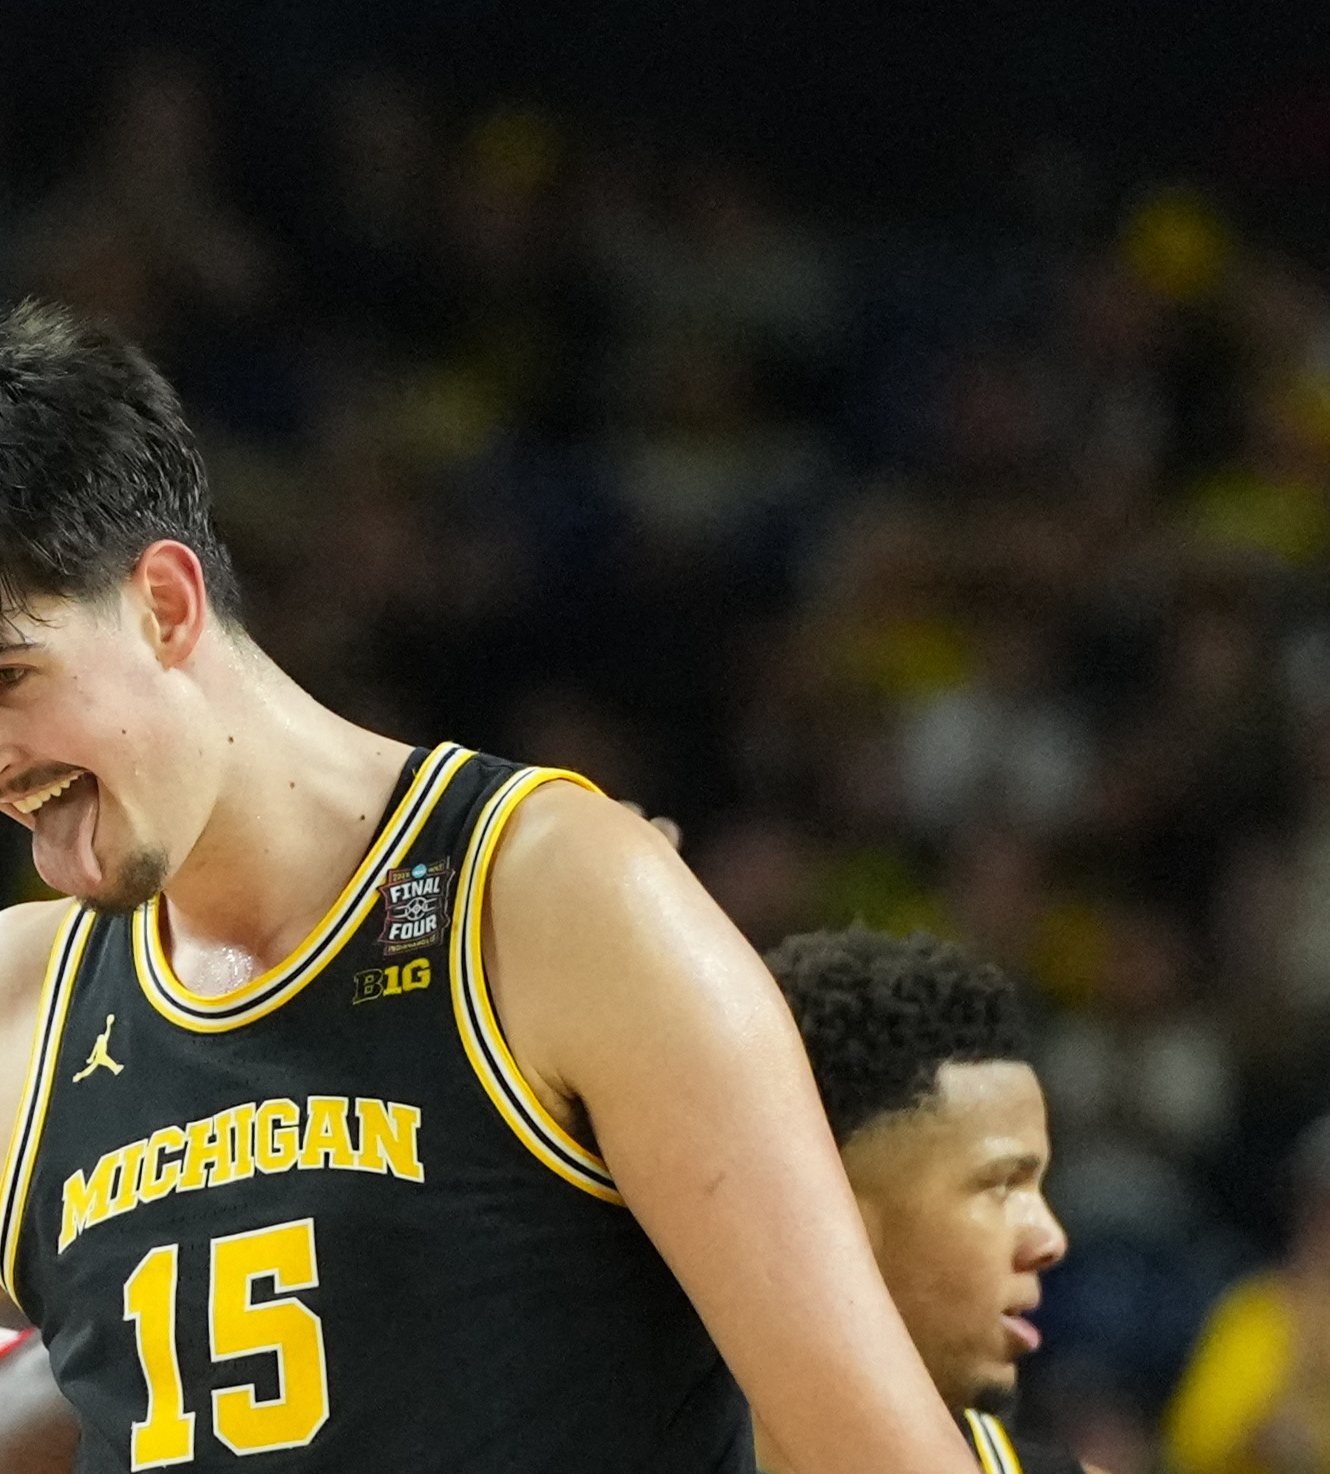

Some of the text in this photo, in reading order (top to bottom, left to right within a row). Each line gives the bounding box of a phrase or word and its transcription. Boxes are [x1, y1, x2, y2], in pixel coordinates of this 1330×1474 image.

[388, 914, 437, 940] FOUR
[389, 876, 440, 904] FINAL
[58, 1096, 424, 1254] MICHIGAN
[123, 1217, 330, 1472] 15
